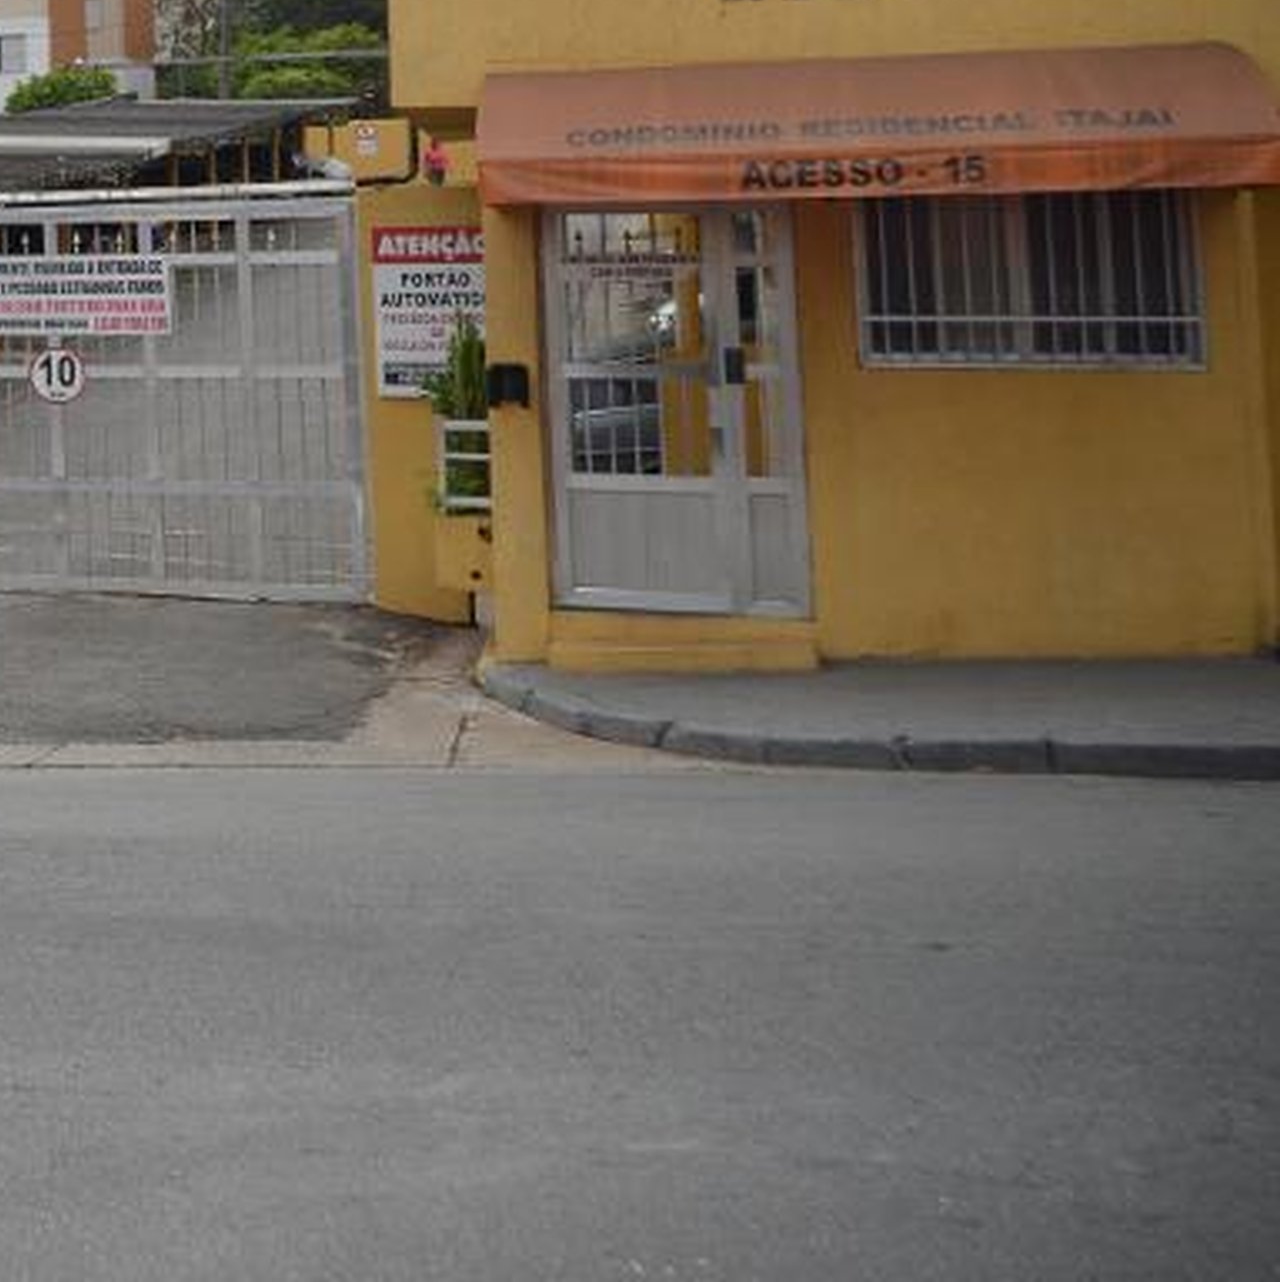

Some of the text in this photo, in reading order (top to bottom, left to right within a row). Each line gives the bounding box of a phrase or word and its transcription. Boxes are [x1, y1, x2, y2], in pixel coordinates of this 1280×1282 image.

[741, 158, 903, 189] ACESSO
[944, 155, 985, 185] 15
[40, 355, 76, 388] 10
